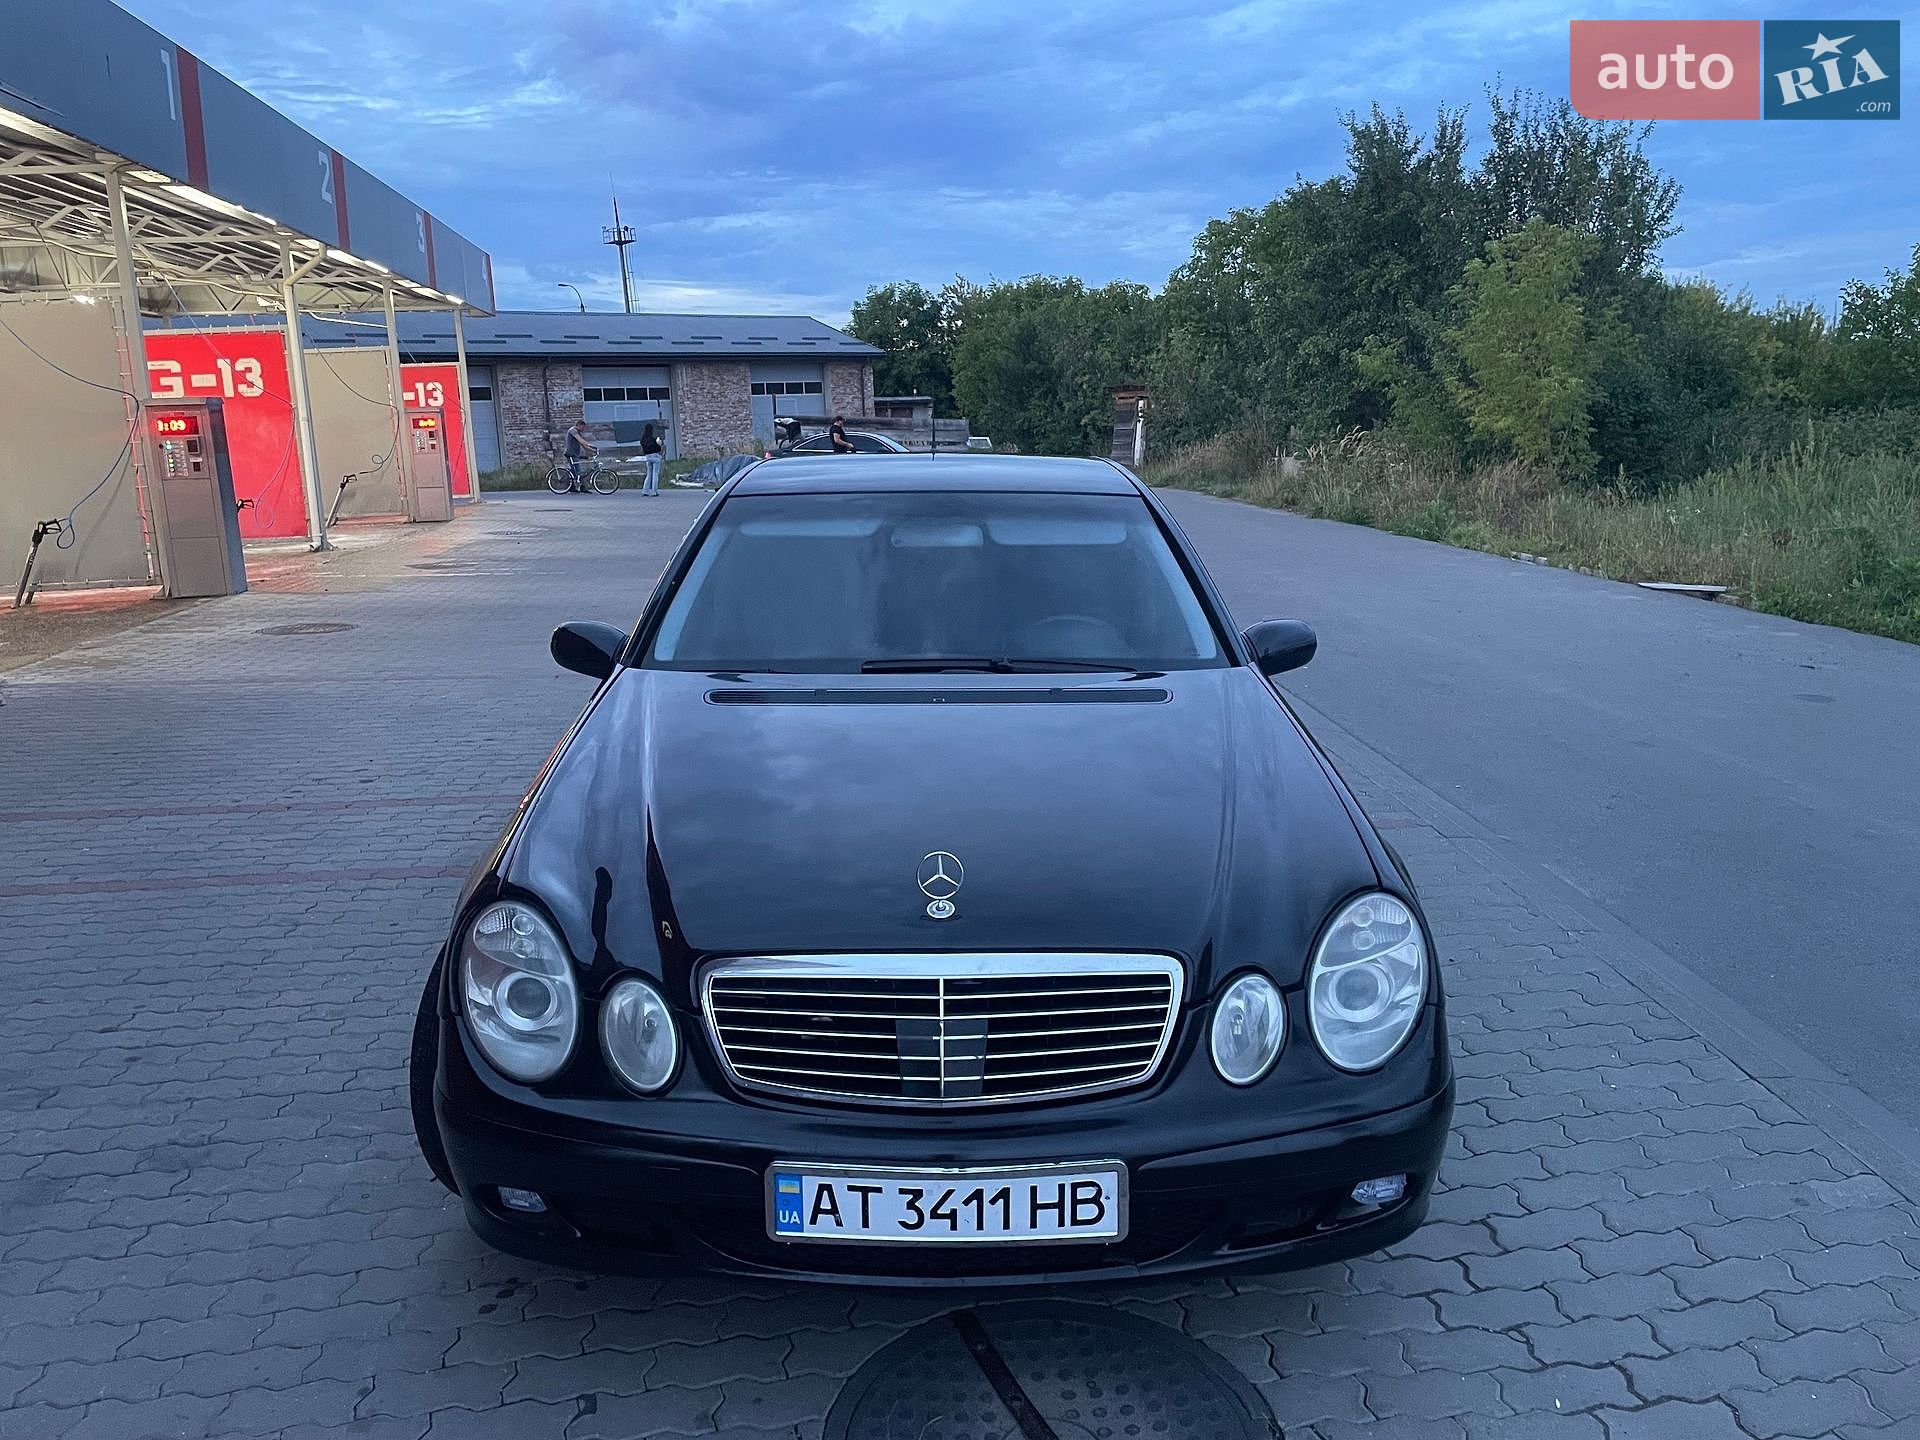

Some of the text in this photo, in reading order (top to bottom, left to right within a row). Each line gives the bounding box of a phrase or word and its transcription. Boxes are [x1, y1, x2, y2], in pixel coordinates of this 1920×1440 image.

[160, 48, 176, 121] 1
[318, 150, 333, 204] 2
[415, 211, 425, 253] 3
[778, 1210, 801, 1225] UA
[809, 1180, 1106, 1231] AT 3411 HB
